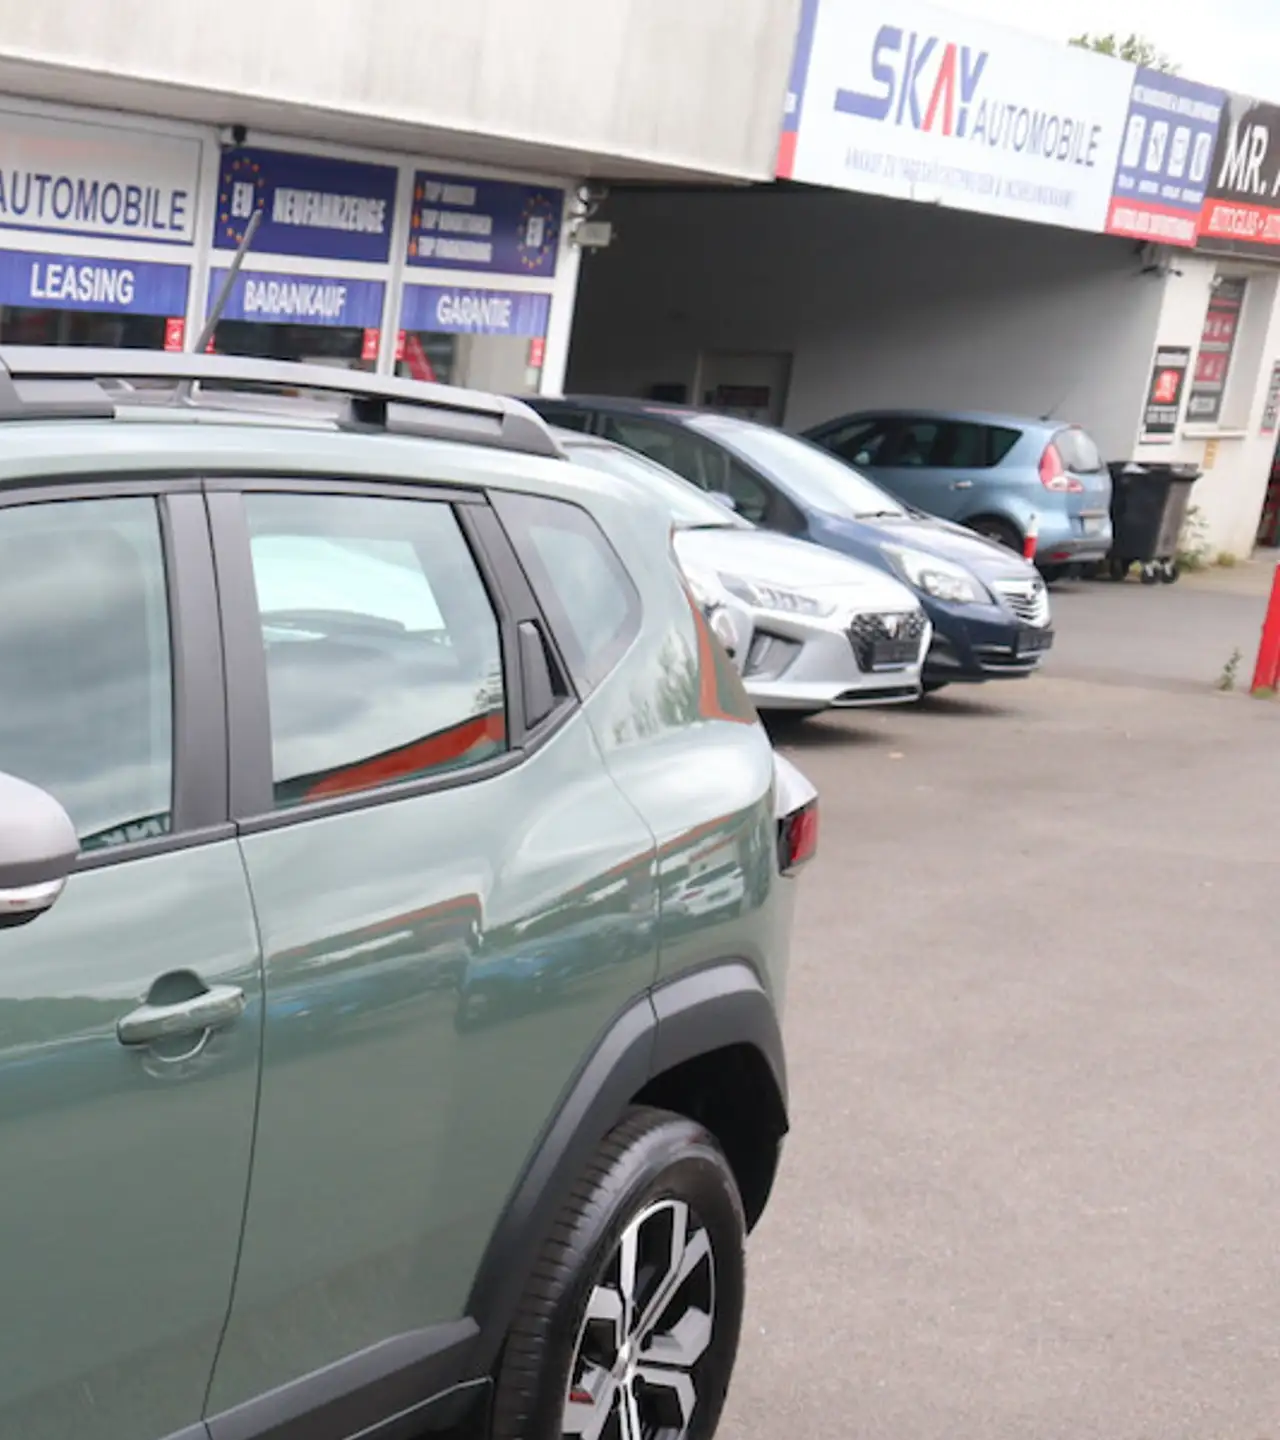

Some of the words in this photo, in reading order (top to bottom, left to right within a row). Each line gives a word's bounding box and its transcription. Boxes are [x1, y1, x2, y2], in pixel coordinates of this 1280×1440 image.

[834, 24, 989, 138] SKAY
[972, 98, 1102, 168] AUTOMOBILE
[272, 187, 386, 234] NEUFAHRZEUGE
[30, 263, 136, 305] LEASING
[243, 280, 348, 317] BARANKAUF
[436, 295, 512, 329] GARANTIE
